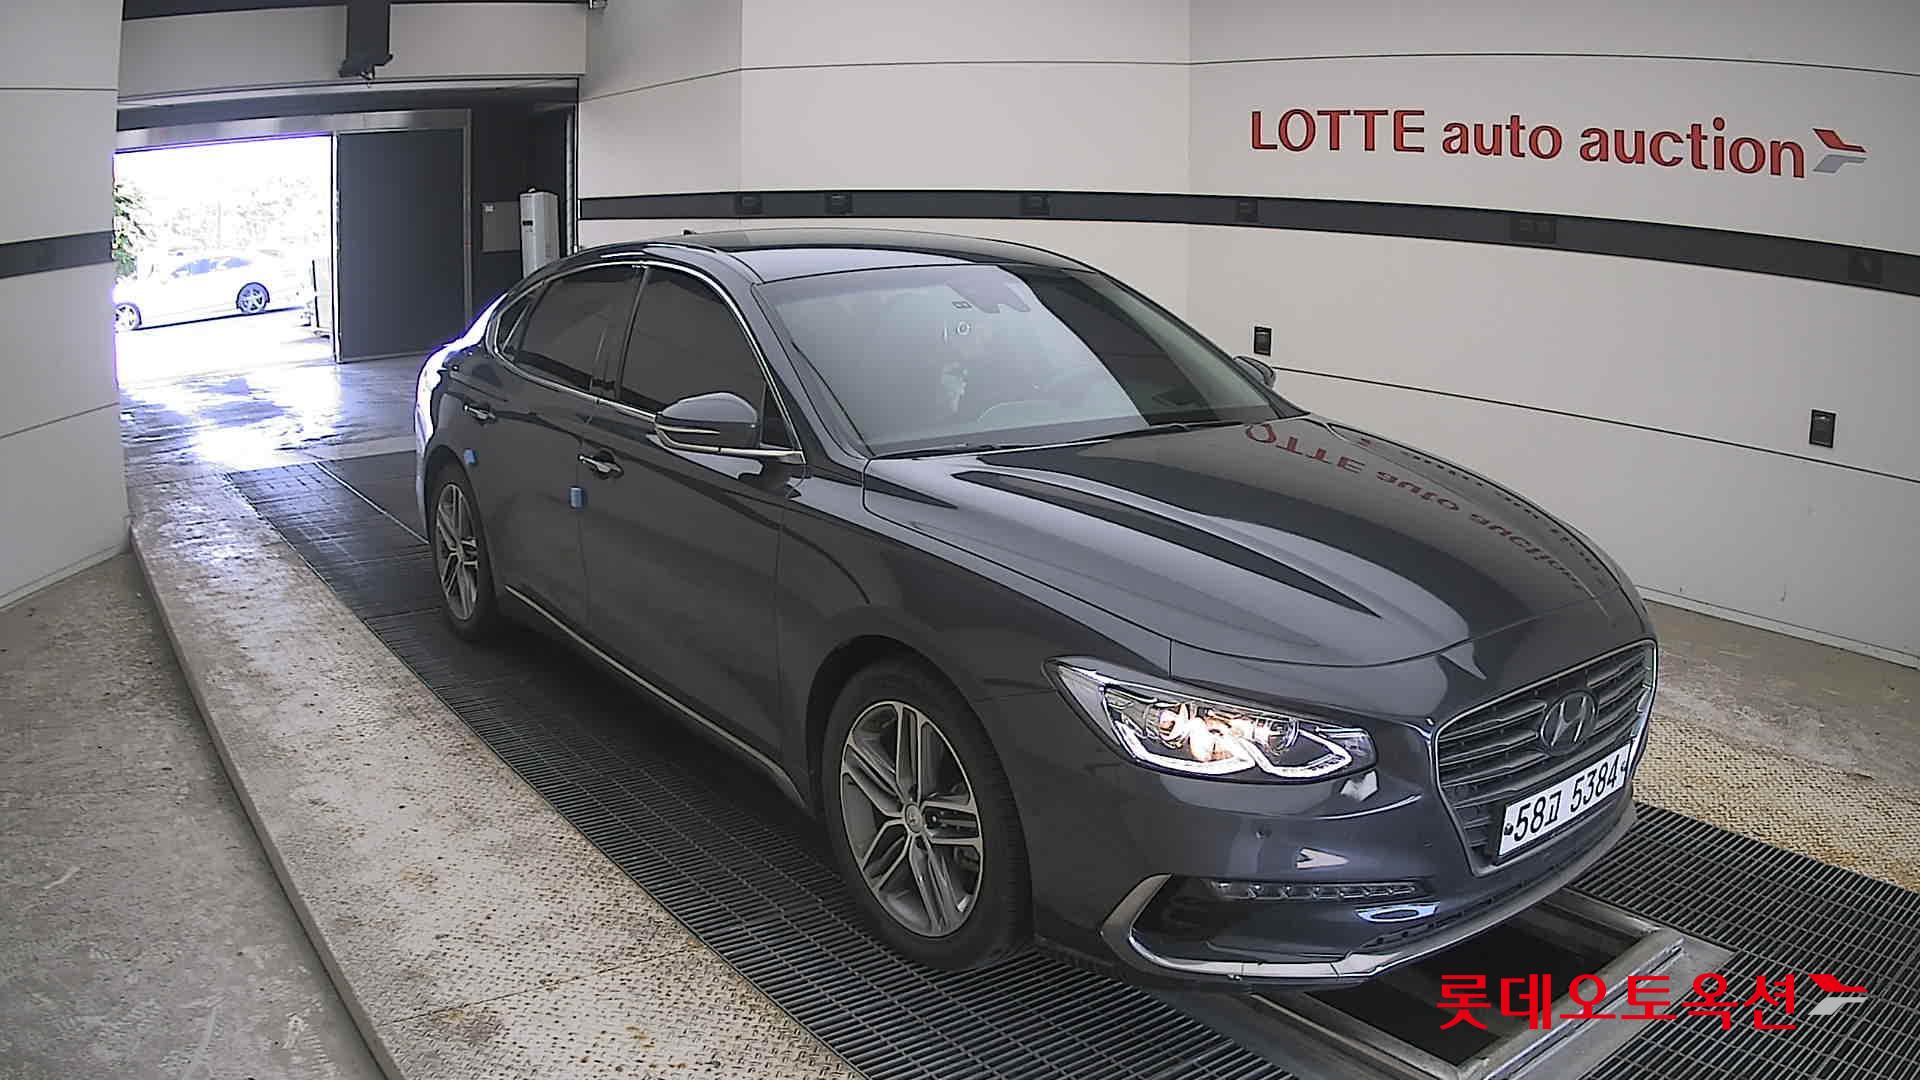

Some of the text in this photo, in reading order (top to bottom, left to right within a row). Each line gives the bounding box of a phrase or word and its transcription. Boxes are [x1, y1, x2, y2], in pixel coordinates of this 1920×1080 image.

[1251, 110, 1805, 178] LOTTE auto auction
[1514, 754, 1620, 842] 58고 5384
